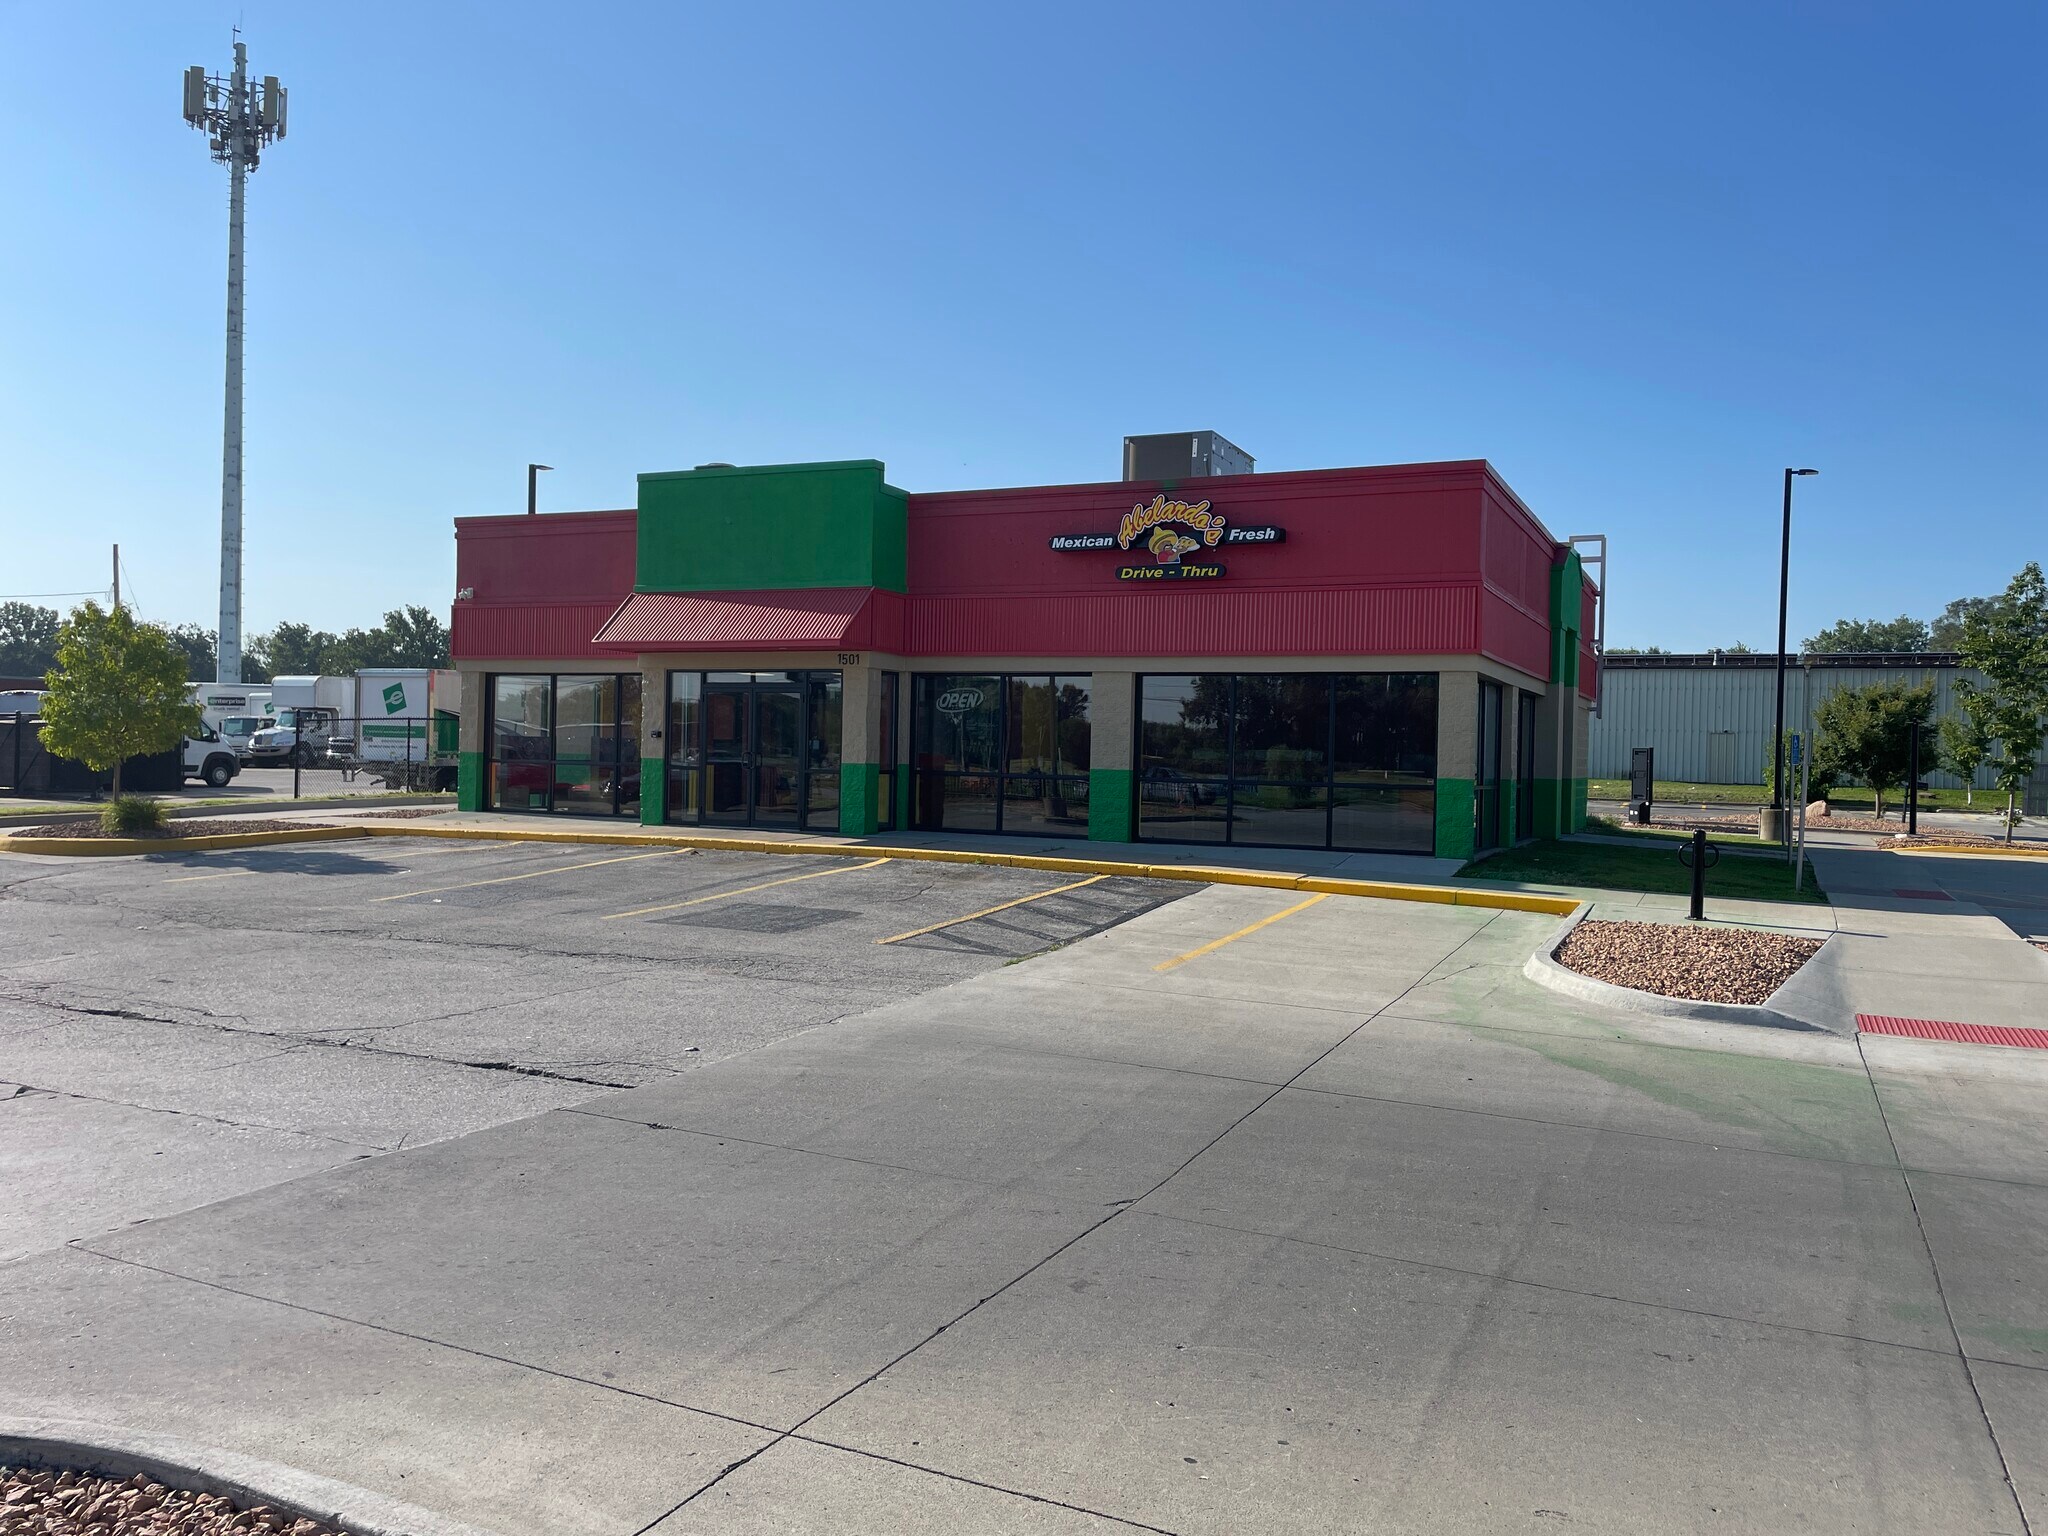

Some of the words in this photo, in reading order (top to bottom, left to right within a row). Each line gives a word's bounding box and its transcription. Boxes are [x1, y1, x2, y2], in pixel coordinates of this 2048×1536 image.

[1228, 528, 1275, 541] Fresh
[1051, 536, 1113, 549] Mexican
[1120, 567, 1164, 579] Drive
[1181, 565, 1219, 577] Thru
[837, 653, 860, 666] 1501
[208, 698, 246, 706] enterprise
[939, 692, 979, 708] OPEN
